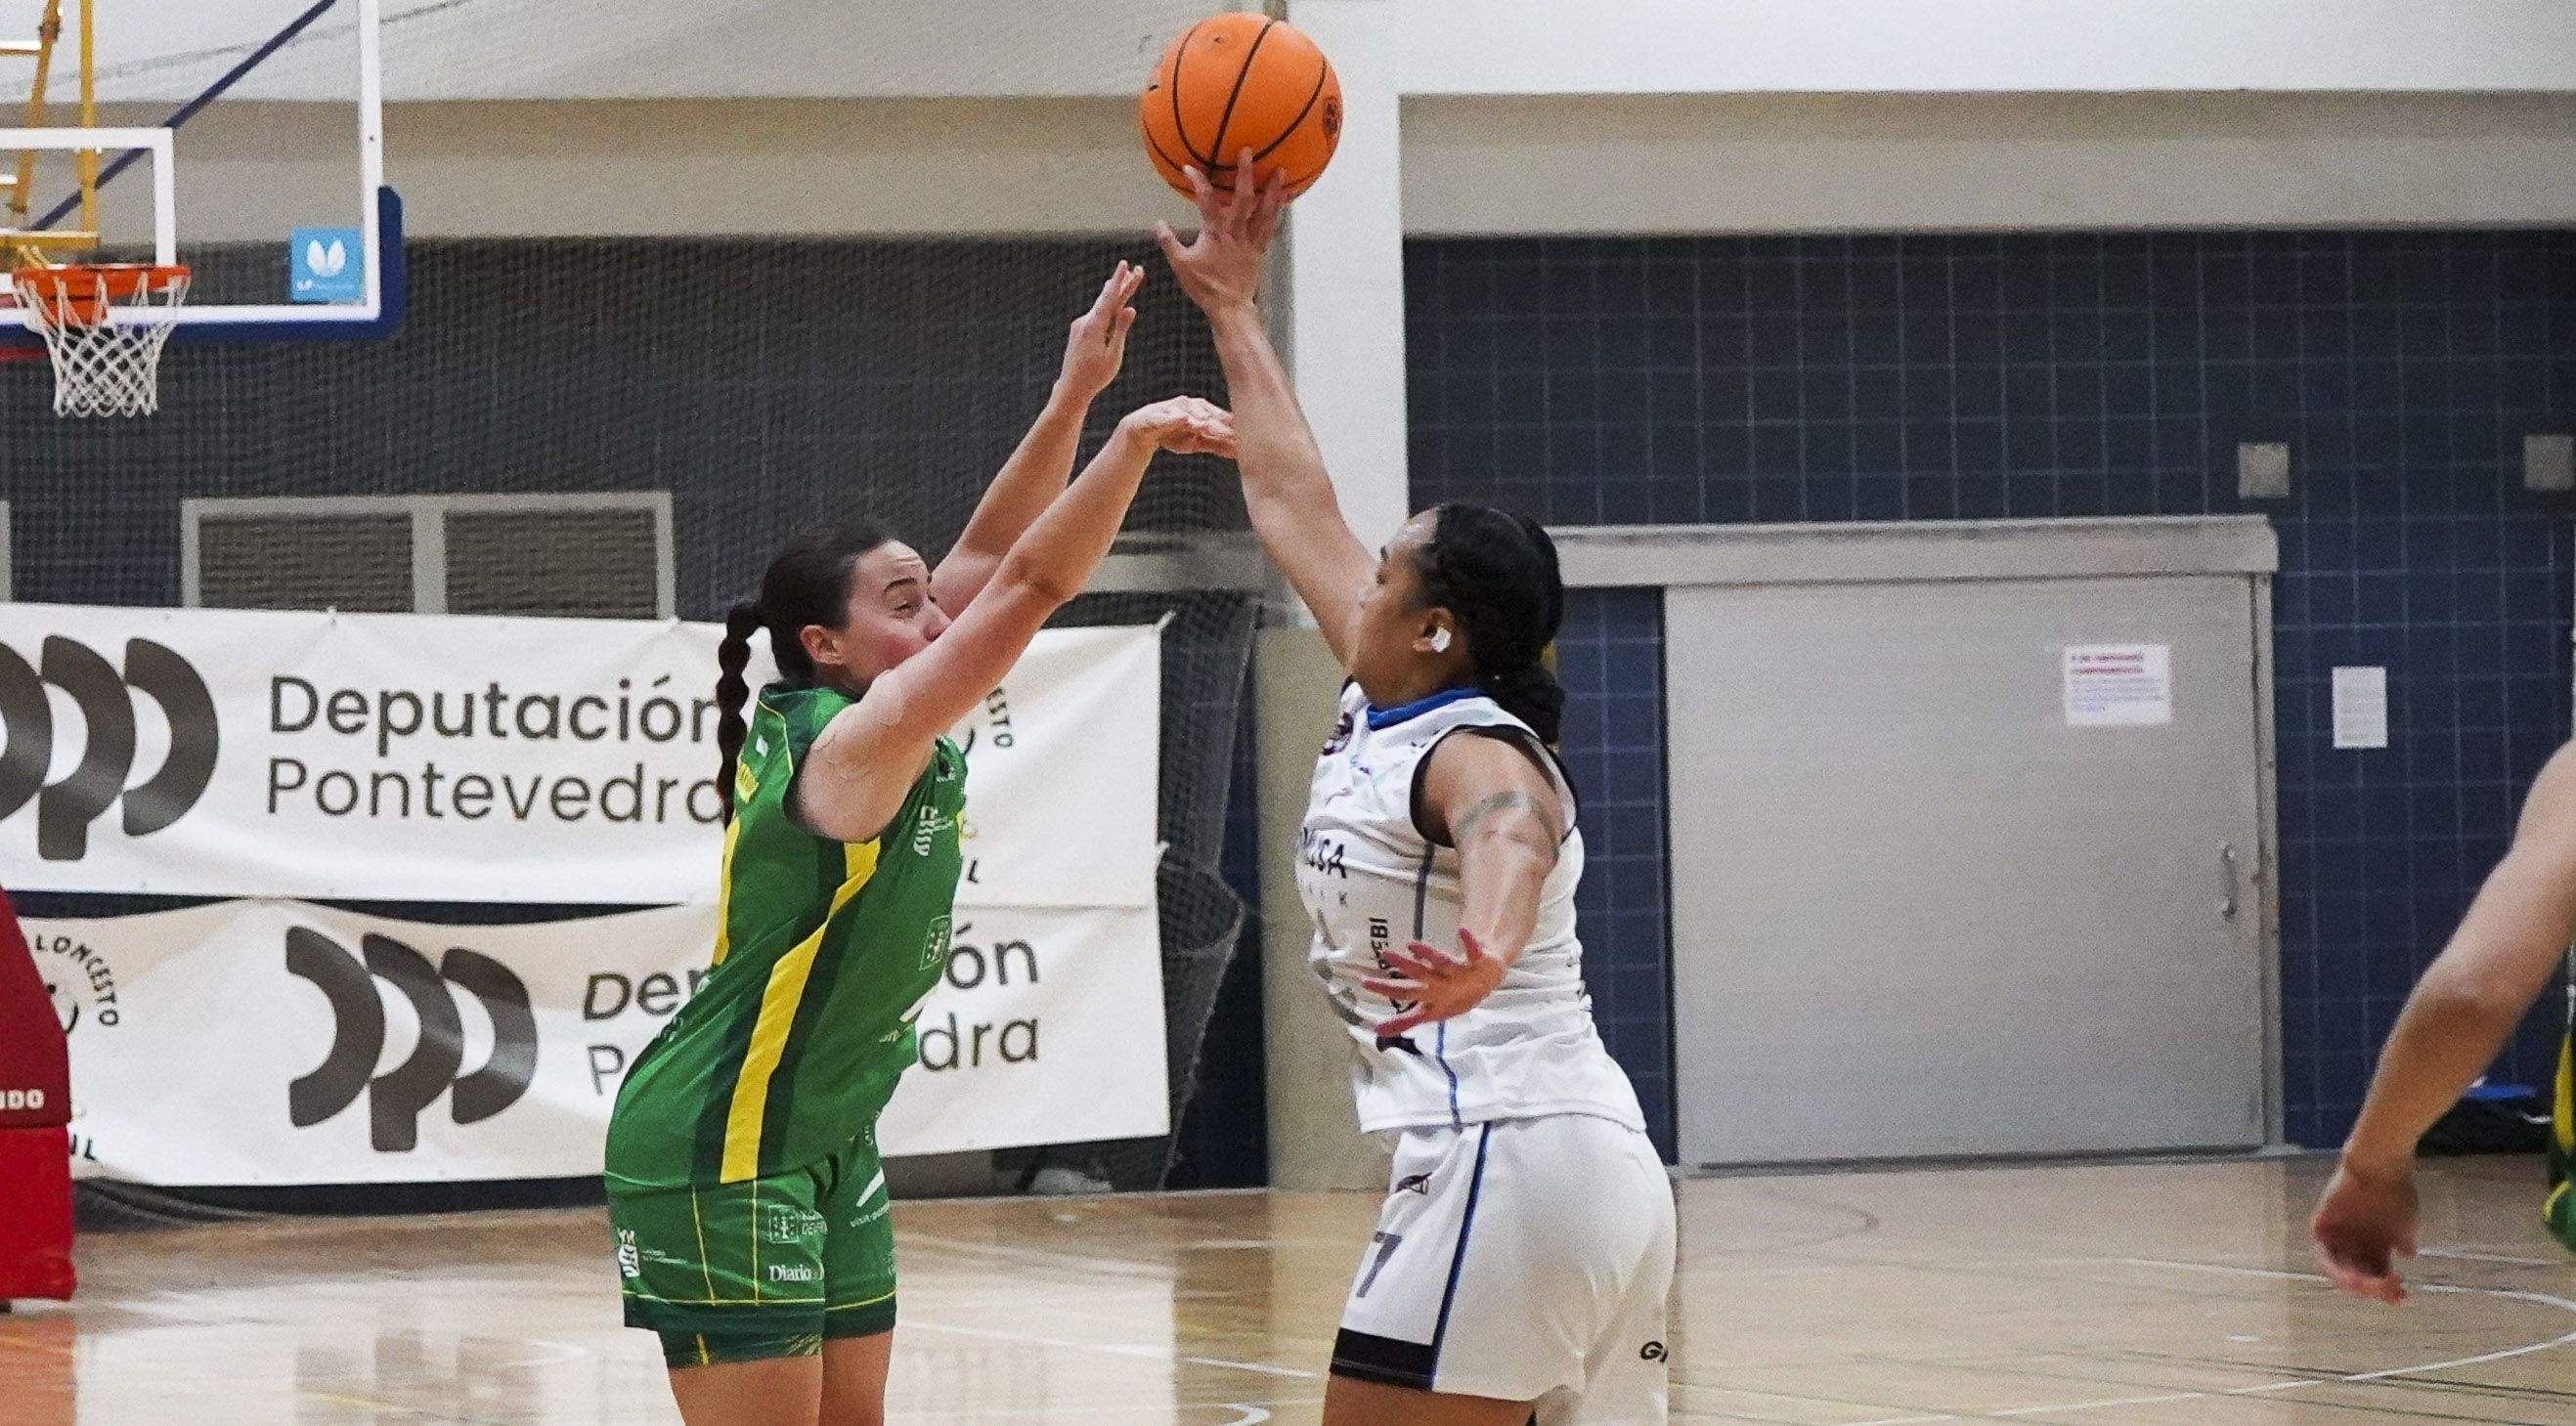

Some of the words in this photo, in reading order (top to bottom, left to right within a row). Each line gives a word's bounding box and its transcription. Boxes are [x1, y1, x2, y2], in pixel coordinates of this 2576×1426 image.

[271, 673, 719, 757] Deputación
[268, 756, 724, 823] Pontevedra
[35, 934, 118, 1026] LONCESTO
